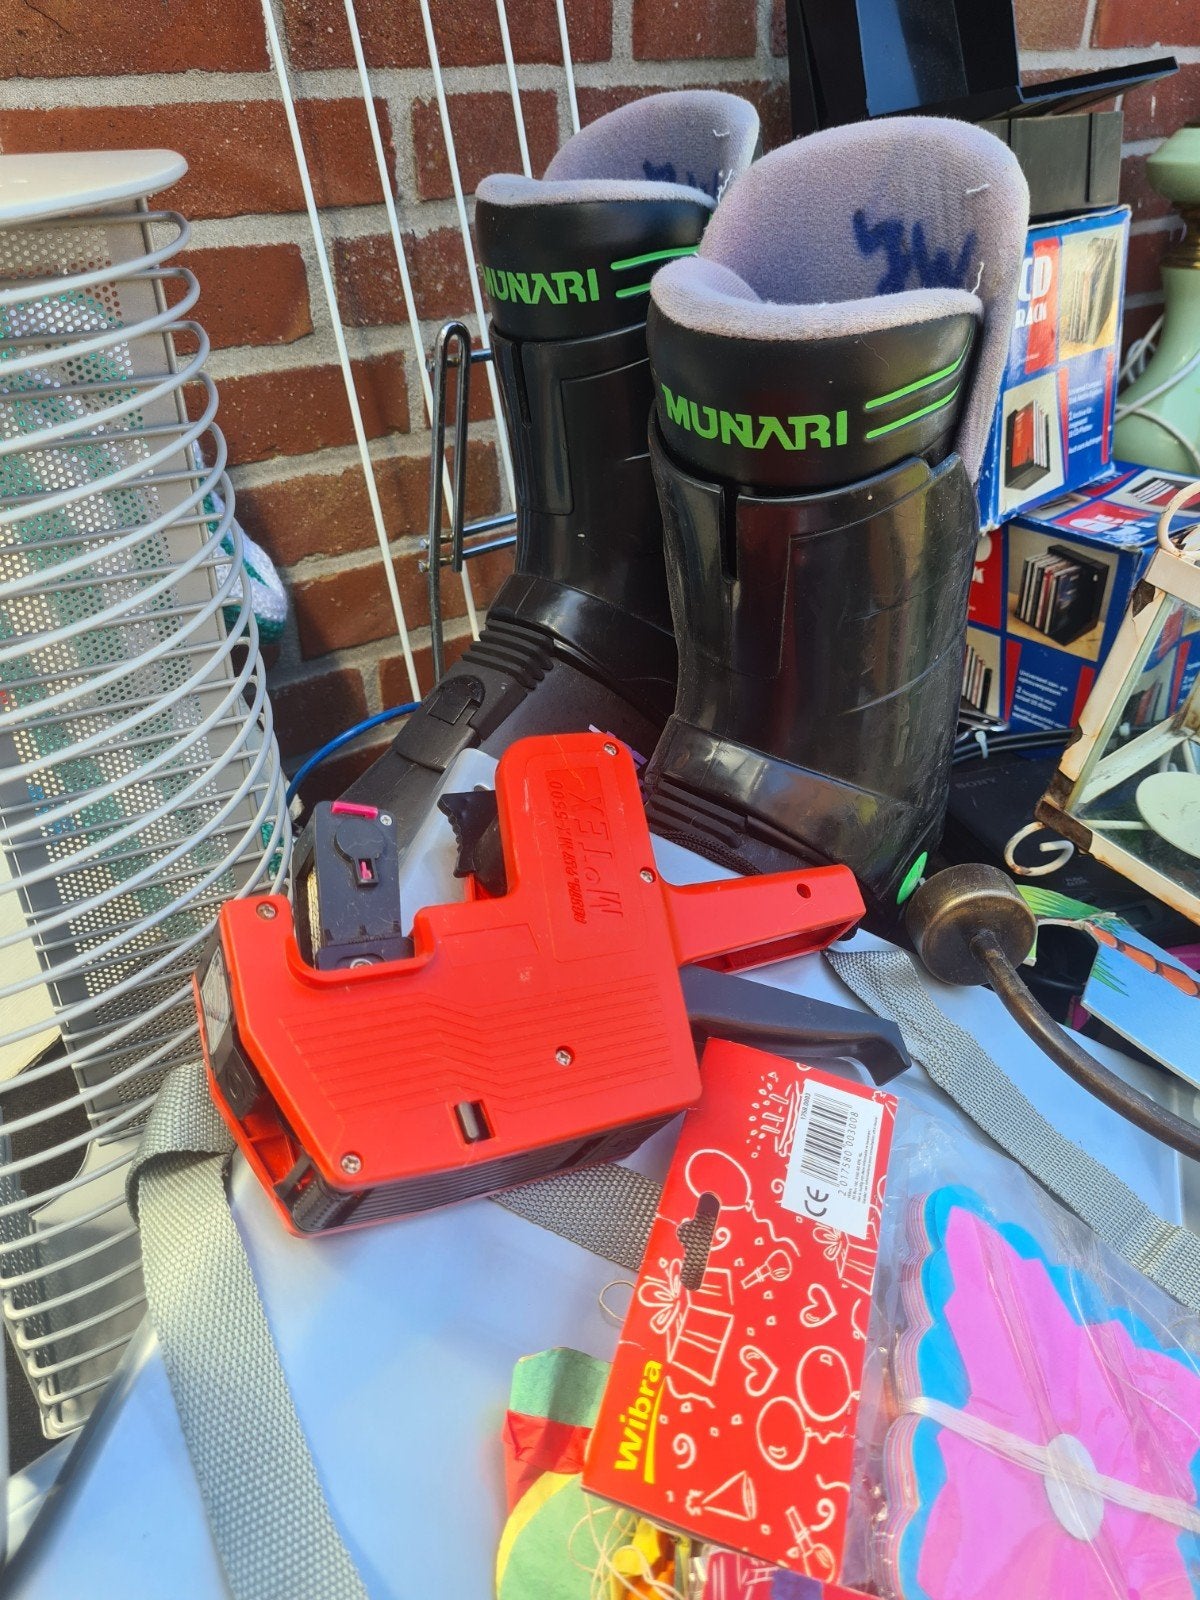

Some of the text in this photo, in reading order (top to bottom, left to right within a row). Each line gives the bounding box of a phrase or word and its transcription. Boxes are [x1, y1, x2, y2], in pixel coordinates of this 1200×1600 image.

[480, 261, 600, 305] MUNARI
[1018, 255, 1053, 301] CD
[661, 382, 848, 451] MUNARI
[845, 1111, 859, 1147] 003008
[840, 1150, 853, 1188] 017580
